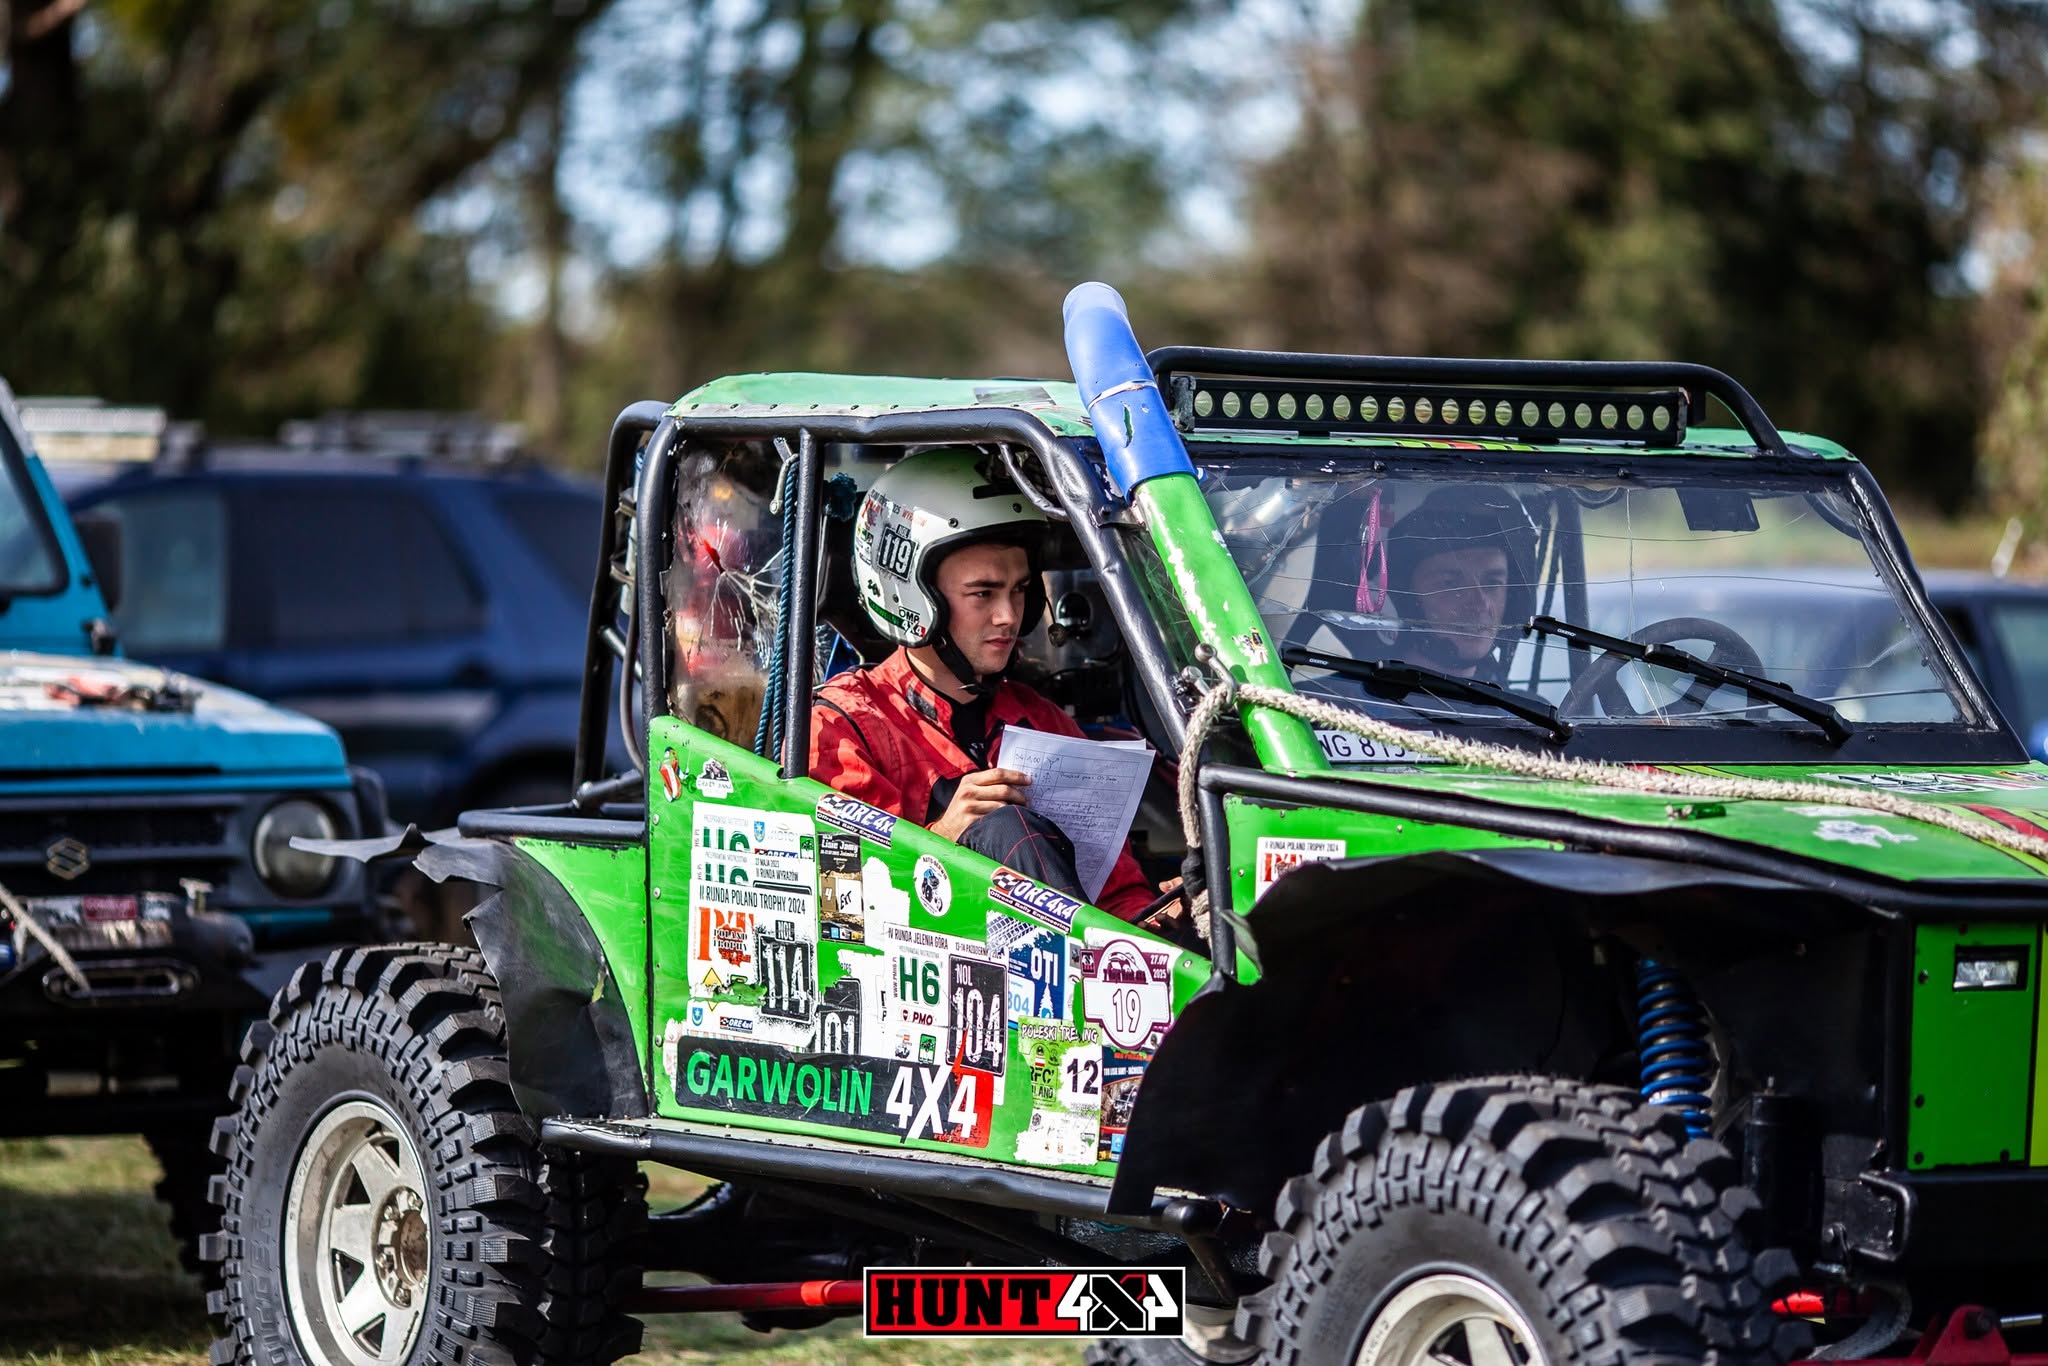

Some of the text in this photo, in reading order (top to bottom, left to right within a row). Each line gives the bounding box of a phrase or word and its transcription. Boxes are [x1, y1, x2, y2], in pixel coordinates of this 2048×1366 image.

[882, 533, 912, 573] 119
[899, 609, 920, 623] OMP
[841, 822, 858, 833] Rally
[1287, 842, 1306, 851] POLAND
[1307, 843, 1325, 852] TROPHY
[705, 886, 730, 904] RUNDA
[731, 889, 758, 908] POLAND
[759, 893, 786, 913] TROPHY
[788, 897, 806, 915] 2024
[990, 890, 1070, 933] Offroad Rally Engineering
[713, 939, 748, 952] TROPHY
[894, 928, 913, 942] RUNDA
[914, 931, 934, 947] JELENIA
[934, 934, 949, 950] GÓRA
[899, 955, 941, 1006] H6
[955, 963, 973, 987] NOL
[1152, 968, 1168, 980] 2025
[912, 1011, 934, 1026] PMO
[1112, 988, 1142, 1034] 19
[952, 986, 1003, 1068] 104
[1021, 1023, 1058, 1041] POLESKI
[687, 1051, 873, 1116] GARWOLIN
[1066, 1058, 1099, 1095] 12
[886, 1065, 979, 1140] 4X4
